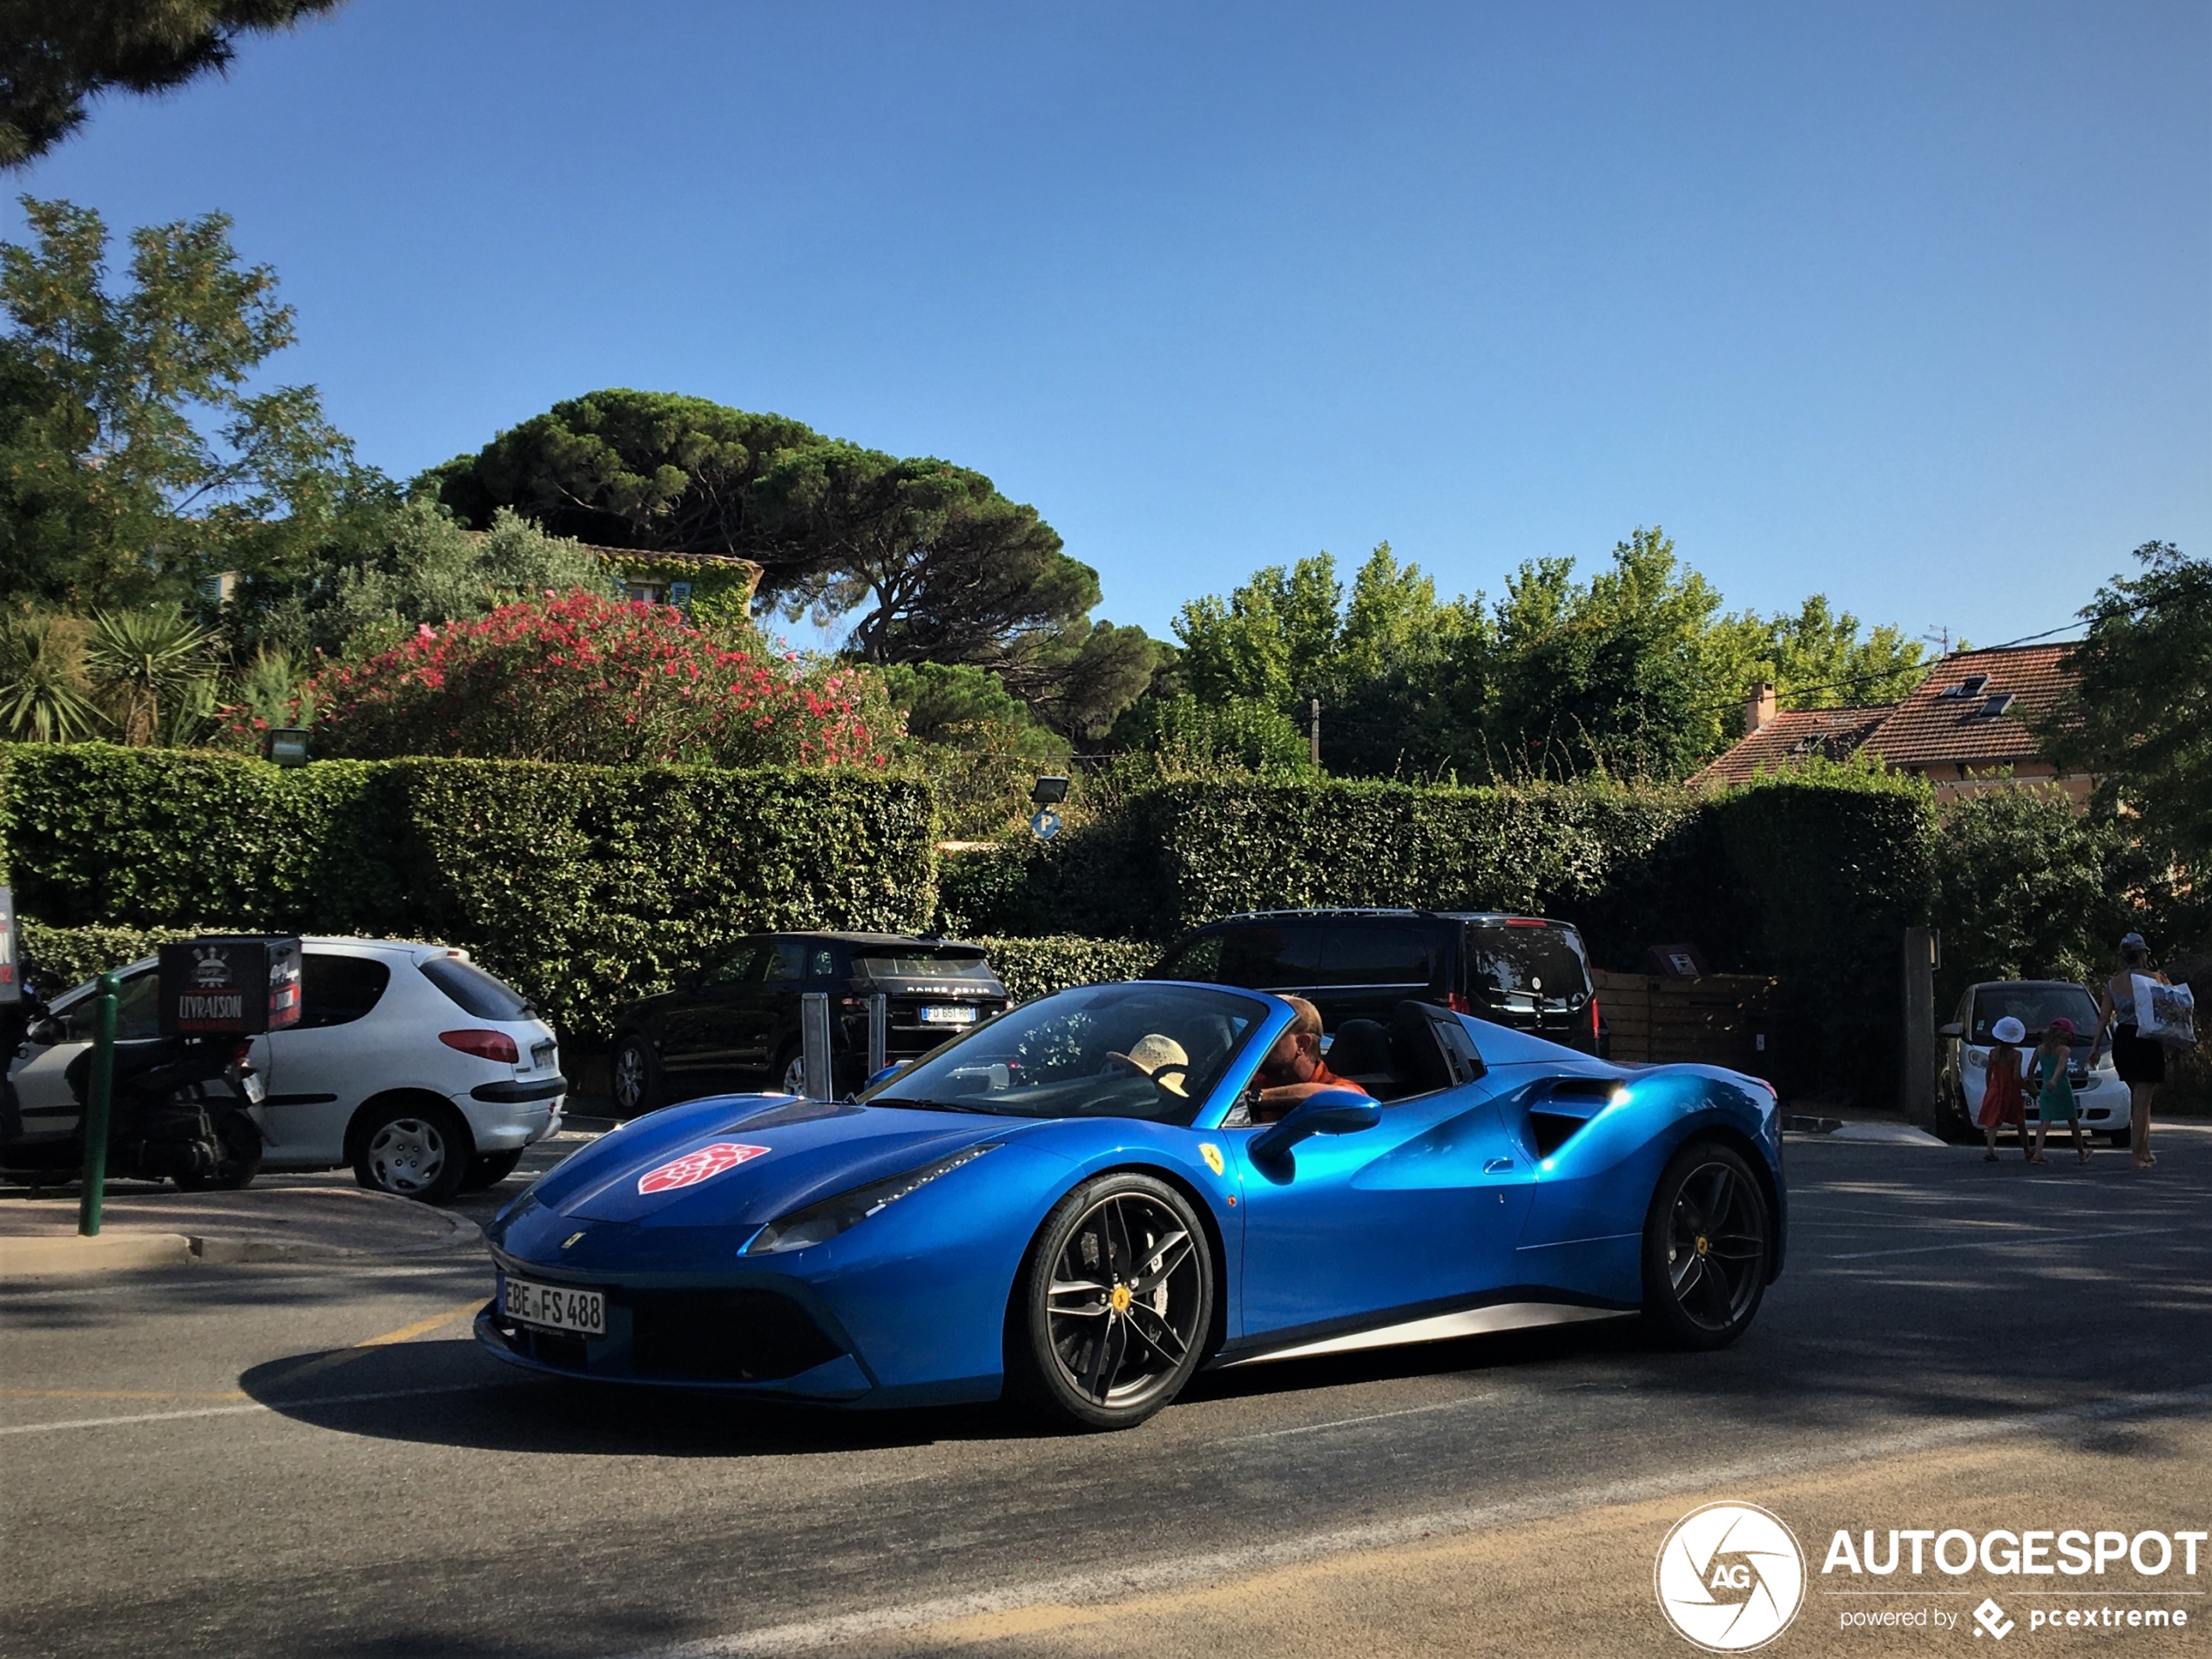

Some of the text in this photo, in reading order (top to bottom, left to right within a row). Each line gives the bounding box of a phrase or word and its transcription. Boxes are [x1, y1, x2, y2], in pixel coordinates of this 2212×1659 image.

[179, 995, 242, 1018] LIVRAISON
[542, 1290, 563, 1324] FS
[567, 1294, 601, 1329] 488
